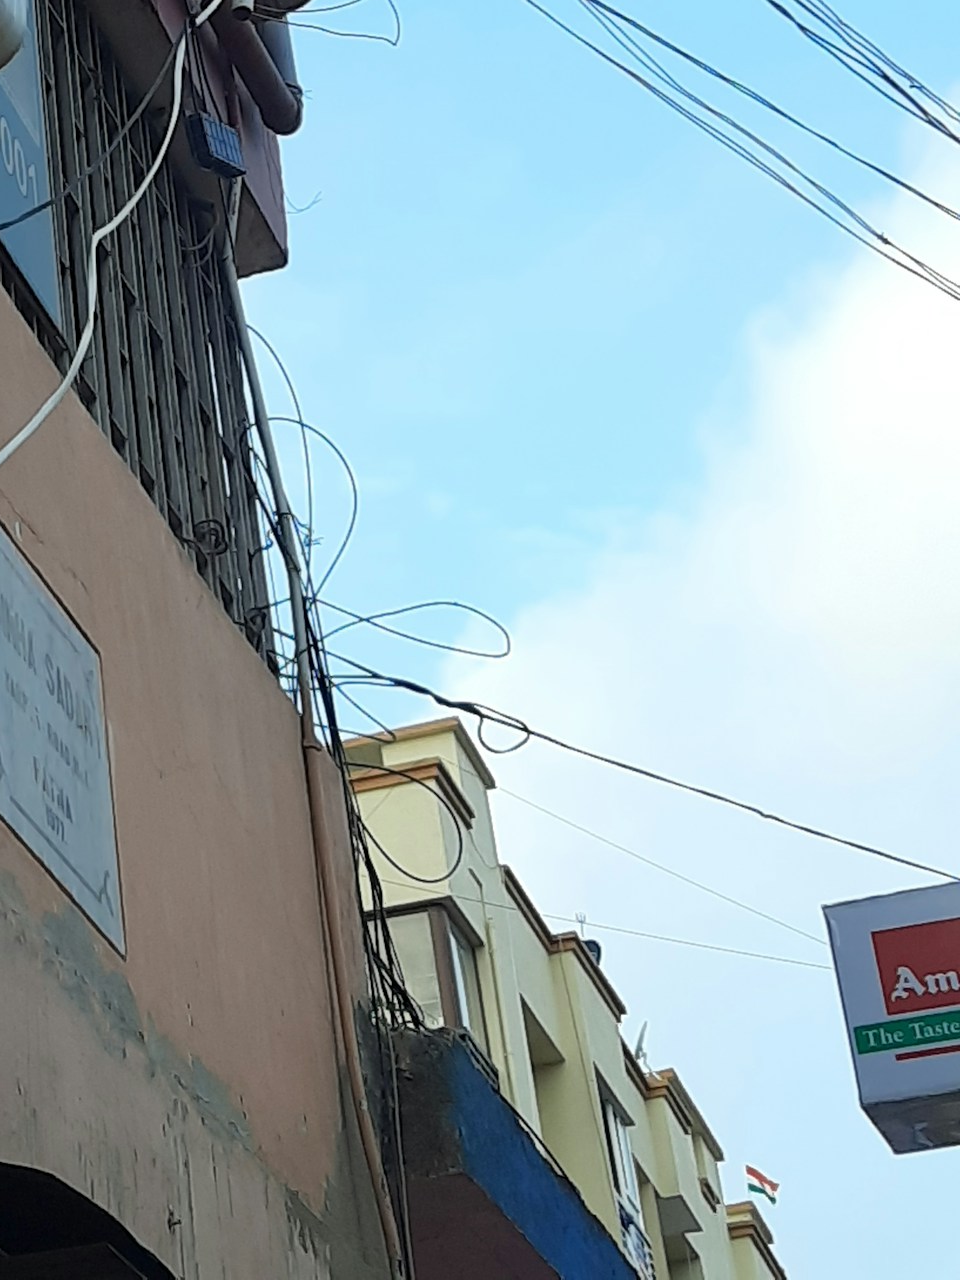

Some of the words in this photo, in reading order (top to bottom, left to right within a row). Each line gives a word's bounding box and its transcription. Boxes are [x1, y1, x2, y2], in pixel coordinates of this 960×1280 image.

[890, 966, 960, 1002] Am
[861, 1027, 905, 1047] The
[908, 1021, 960, 1039] Taste
